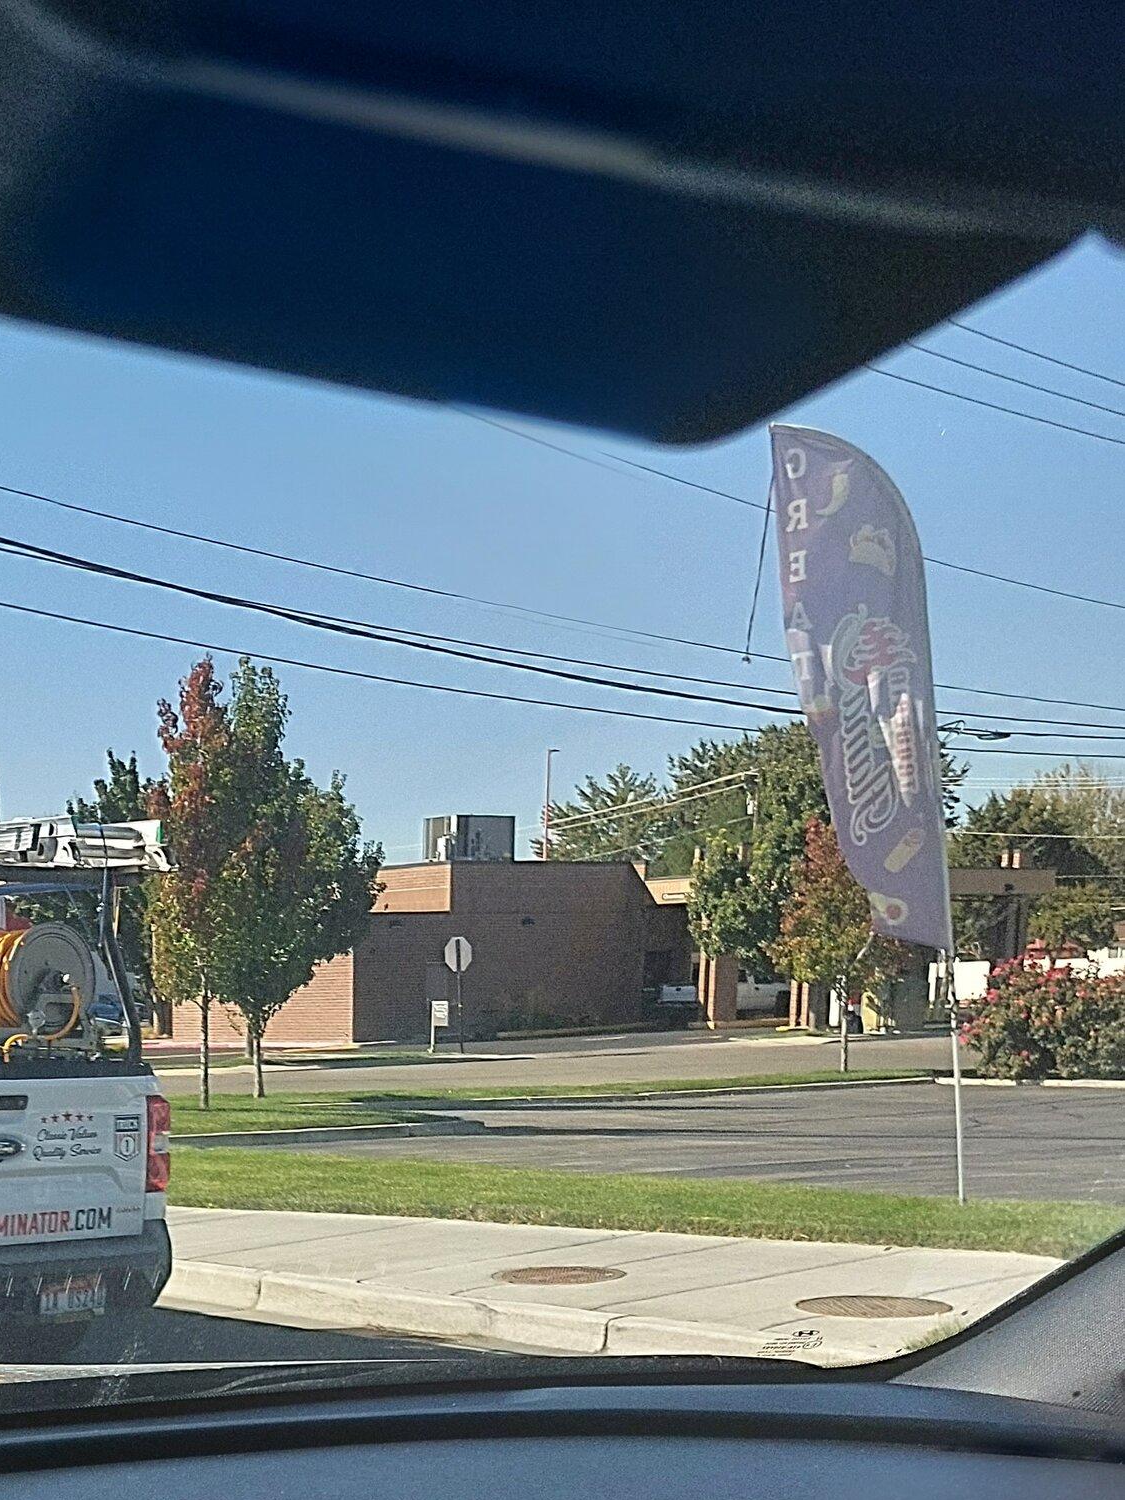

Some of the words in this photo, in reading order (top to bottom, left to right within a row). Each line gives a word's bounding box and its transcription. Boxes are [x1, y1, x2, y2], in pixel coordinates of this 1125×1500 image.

[37, 1128, 68, 1142] Classic
[33, 1145, 65, 1161] Quality
[69, 1143, 102, 1157] Service
